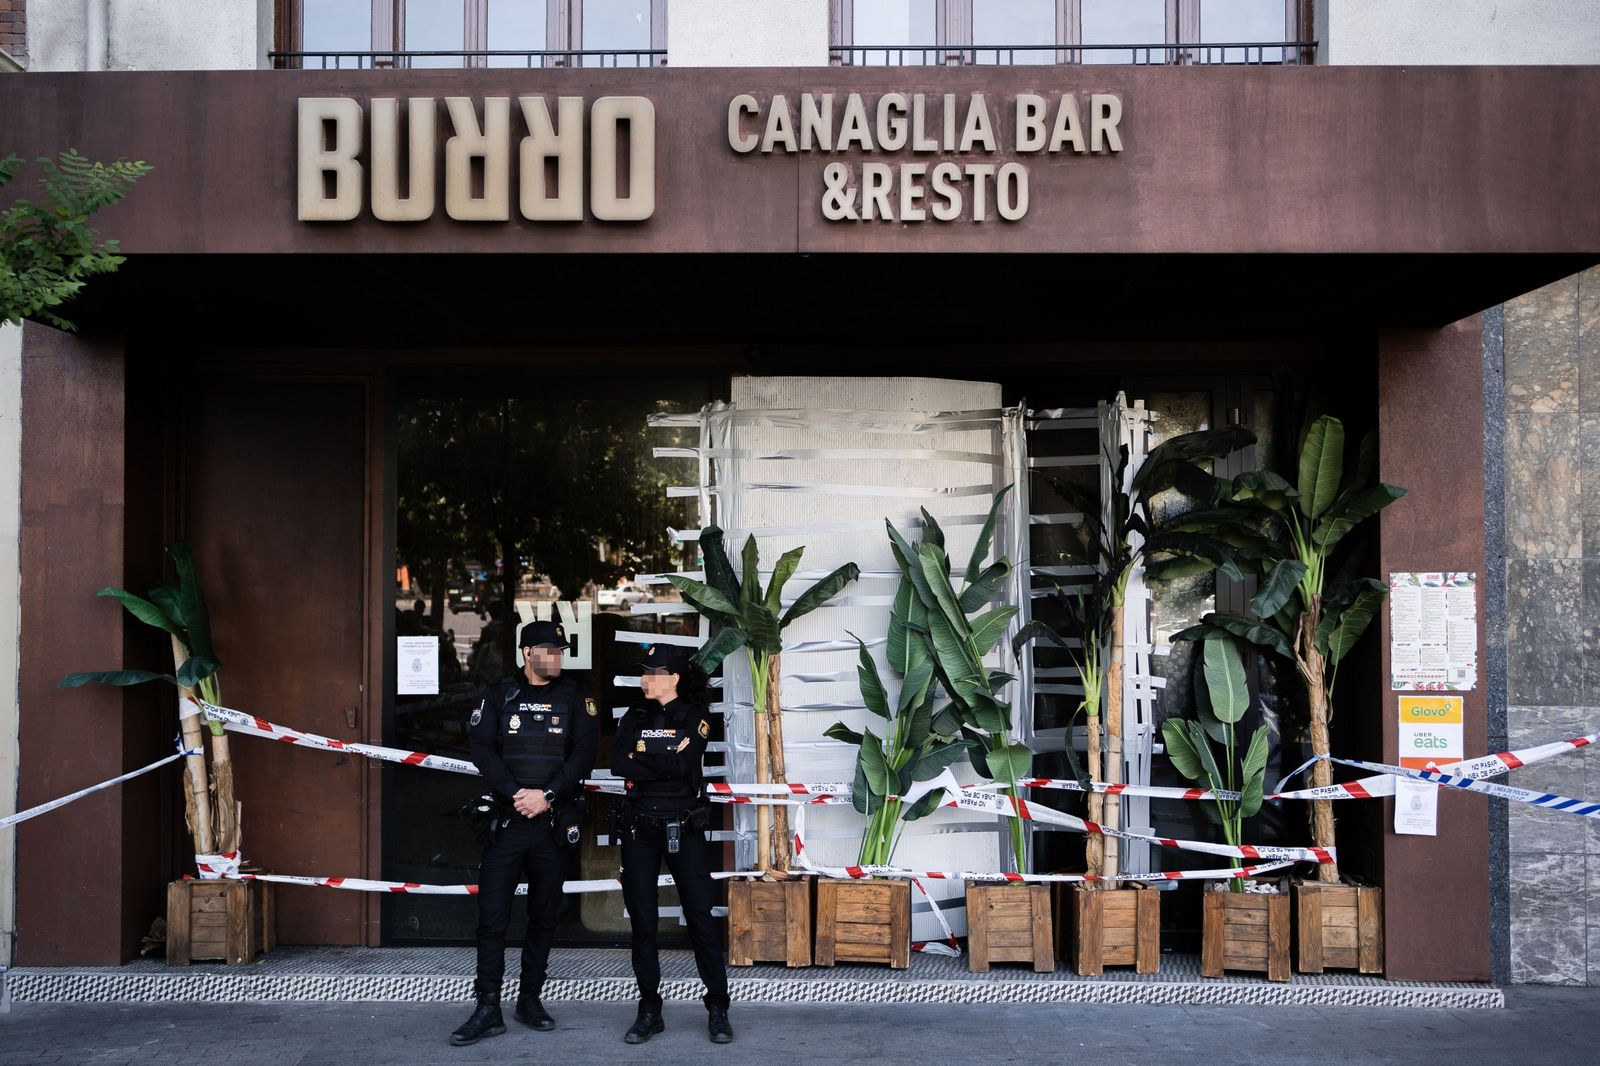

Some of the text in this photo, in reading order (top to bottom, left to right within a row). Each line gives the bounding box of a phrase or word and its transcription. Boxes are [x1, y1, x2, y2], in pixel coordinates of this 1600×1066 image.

[728, 93, 1123, 153] CANAGLIA BAR
[298, 96, 655, 221] BURRO
[821, 162, 1029, 221] &RESTO
[1411, 706, 1446, 717] Glovo
[1414, 736, 1448, 748] eats
[1480, 760, 1497, 768] PASAR
